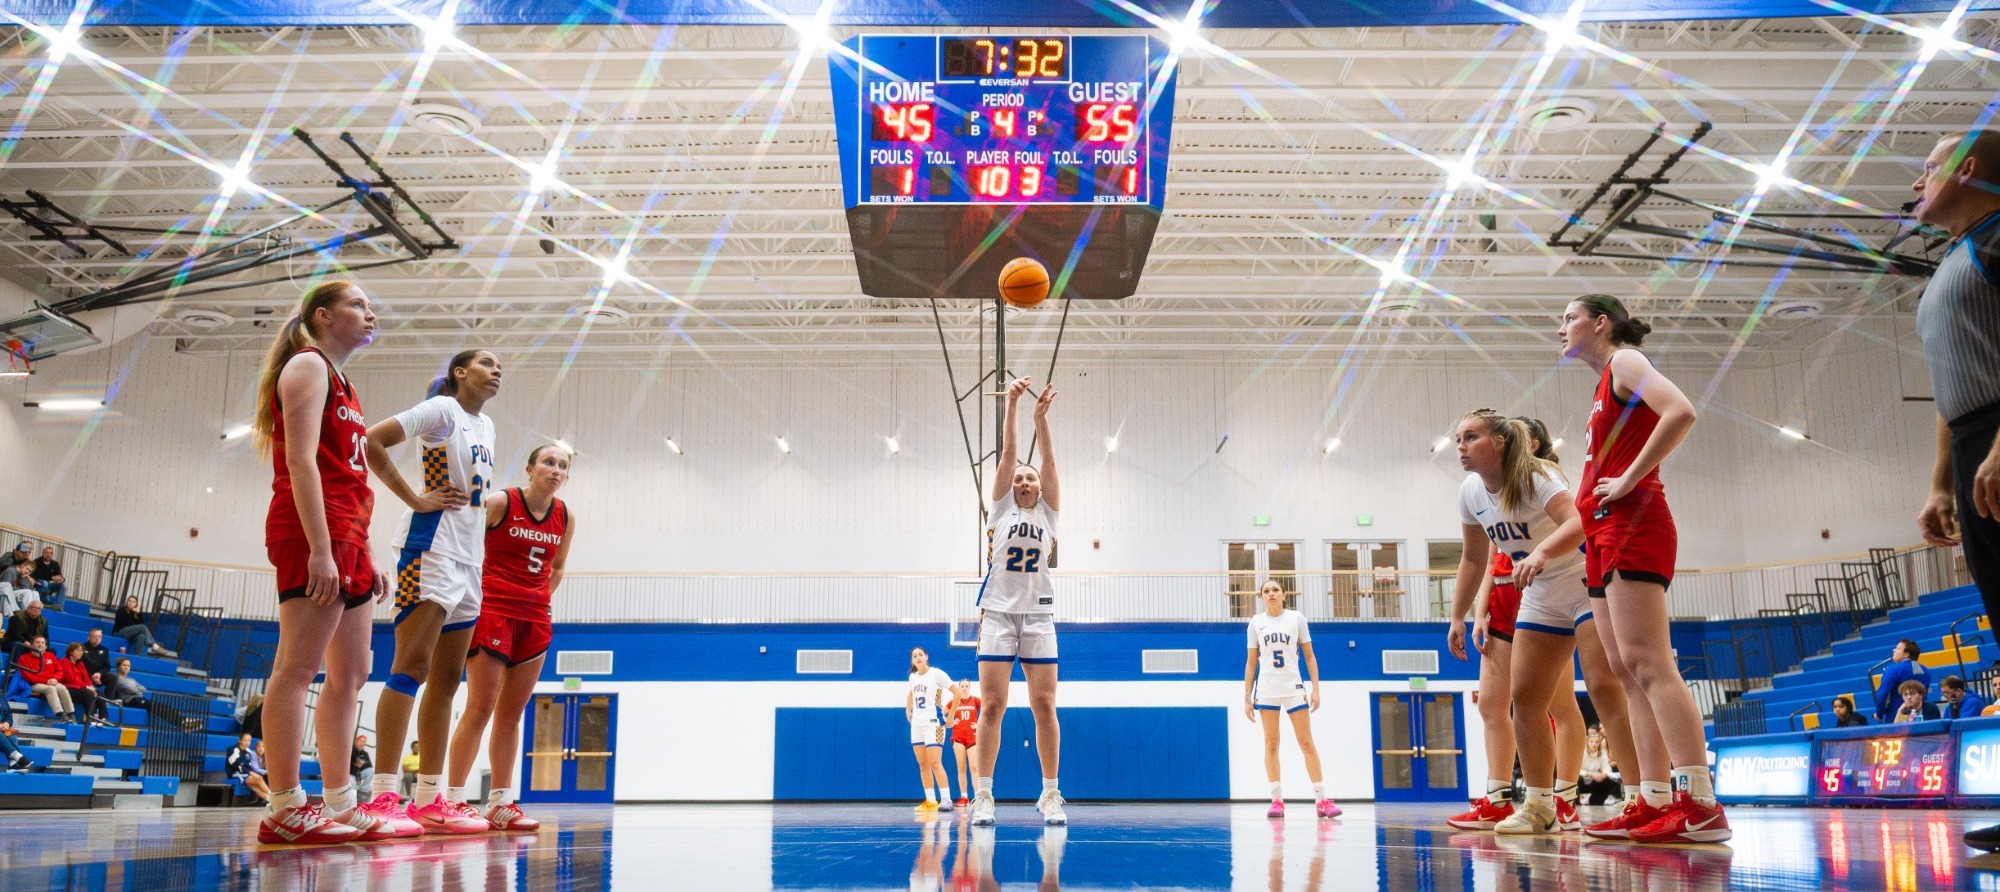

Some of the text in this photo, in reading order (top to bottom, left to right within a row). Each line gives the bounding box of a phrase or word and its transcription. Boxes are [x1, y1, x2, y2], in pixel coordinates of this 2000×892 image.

[975, 40, 1064, 77] 7:32
[870, 81, 934, 102] HOME
[982, 93, 1024, 107] PERIOD
[1068, 81, 1142, 102] GUEST
[884, 104, 931, 141] 45
[970, 111, 980, 122] P
[994, 110, 1014, 136] 4
[1027, 111, 1037, 122] P
[1087, 104, 1134, 141] 55
[970, 125, 981, 136] B
[1027, 125, 1037, 136] B
[870, 149, 914, 165] FOULS
[925, 151, 955, 164] T.O.L.
[966, 151, 1044, 164] PLAYER FOUL
[1053, 151, 1083, 164] T.O.L.
[1094, 149, 1137, 165] FOULS
[904, 168, 913, 194] 1
[981, 166, 1010, 197] 10
[1021, 166, 1040, 197] 3
[1127, 168, 1136, 194] 1
[869, 195, 914, 203] SETS WON
[1093, 195, 1138, 203] SETS WON
[470, 444, 493, 467] POL
[508, 526, 562, 546] ONEONTA
[1007, 521, 1044, 543] POLY
[1487, 521, 1533, 545] POLY
[527, 546, 546, 574] 5
[1006, 546, 1041, 573] 22
[1263, 632, 1291, 647] POLY
[1272, 650, 1285, 668] 5
[913, 683, 928, 694] POLY
[915, 696, 926, 709] 12
[960, 710, 970, 721] 10
[1871, 740, 1902, 765] 7:32
[1922, 754, 1945, 764] GUEST
[1718, 757, 1757, 784] SUNY
[1823, 768, 1840, 792] 45
[1874, 768, 1885, 791] 4
[1922, 765, 1943, 791] 55
